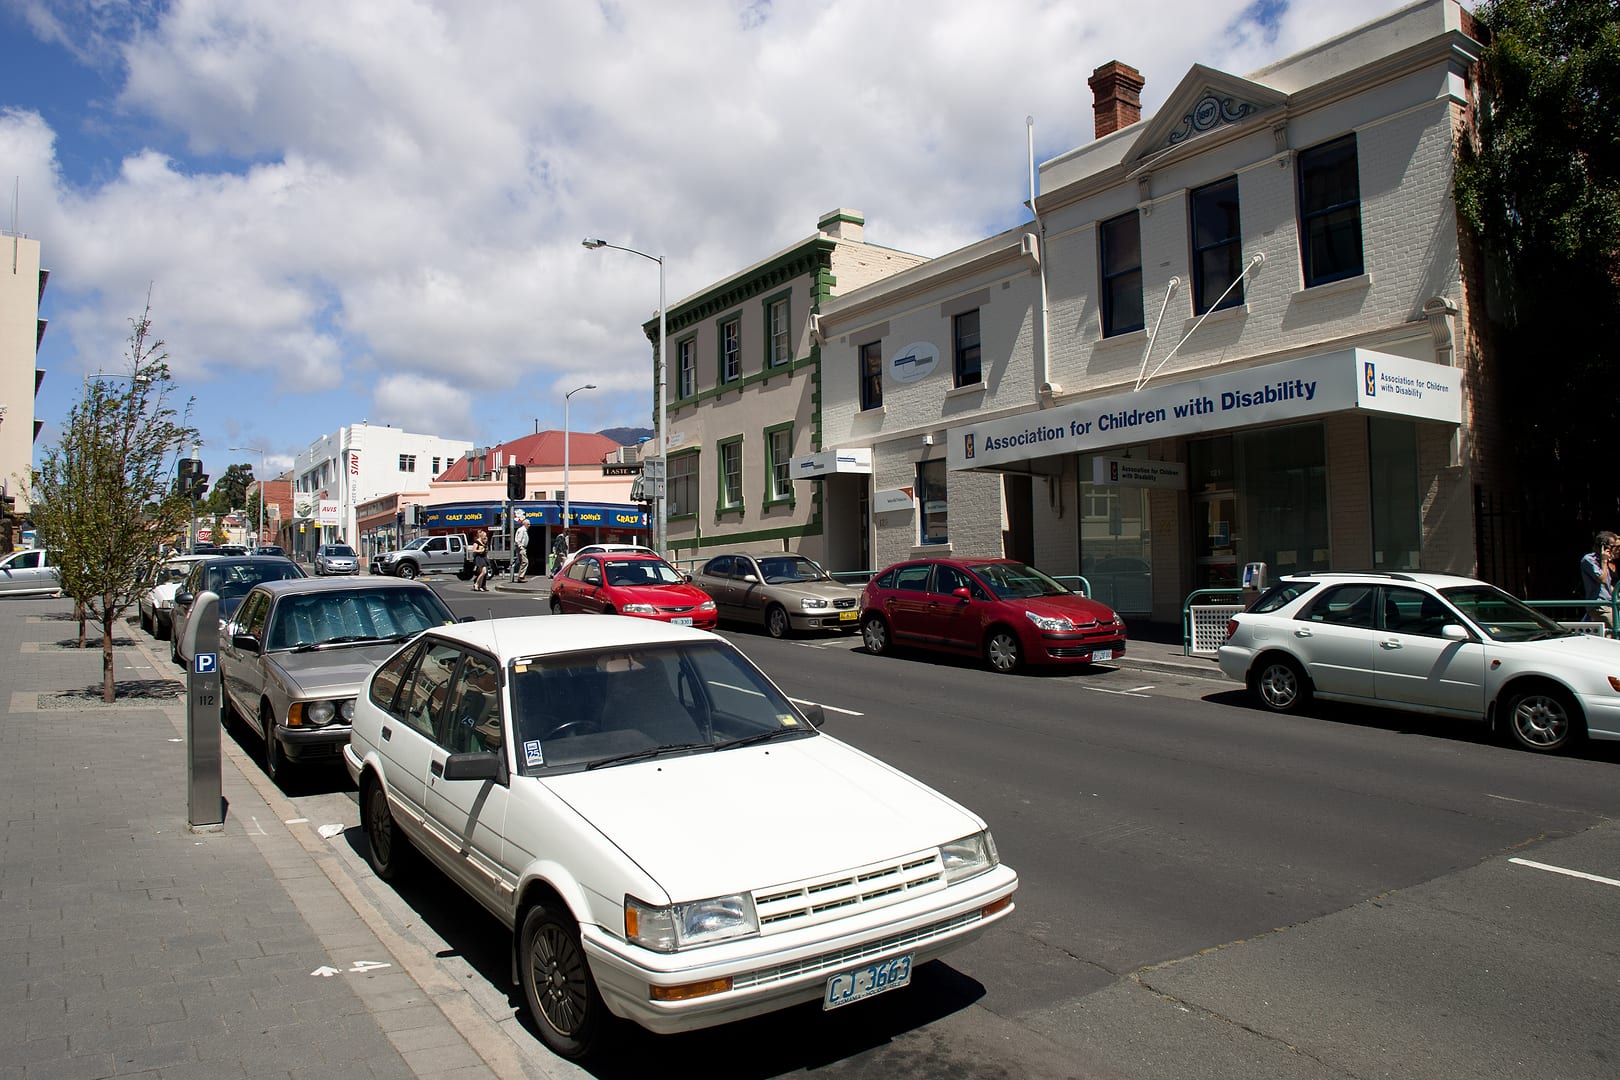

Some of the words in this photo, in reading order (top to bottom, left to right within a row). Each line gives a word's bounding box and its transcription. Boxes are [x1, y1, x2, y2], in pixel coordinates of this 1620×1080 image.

[1380, 372, 1414, 386] Association
[1416, 379, 1425, 388] for
[1426, 381, 1449, 392] Children
[1381, 384, 1394, 392] with
[1395, 385, 1423, 399] Disability
[984, 426, 1064, 452] Association
[1070, 420, 1092, 436] for
[1098, 409, 1166, 432] Children
[1174, 397, 1214, 418] with
[1221, 379, 1317, 411] Disability
[350, 453, 359, 475] AVIS
[1122, 465, 1150, 474] Association
[1150, 466, 1158, 475] for
[1159, 468, 1179, 476] Children
[1134, 473, 1157, 482] Disability
[580, 512, 602, 521] JOHN'S
[616, 514, 639, 523] CRAZY
[199, 655, 213, 671] P
[199, 695, 215, 706] 112
